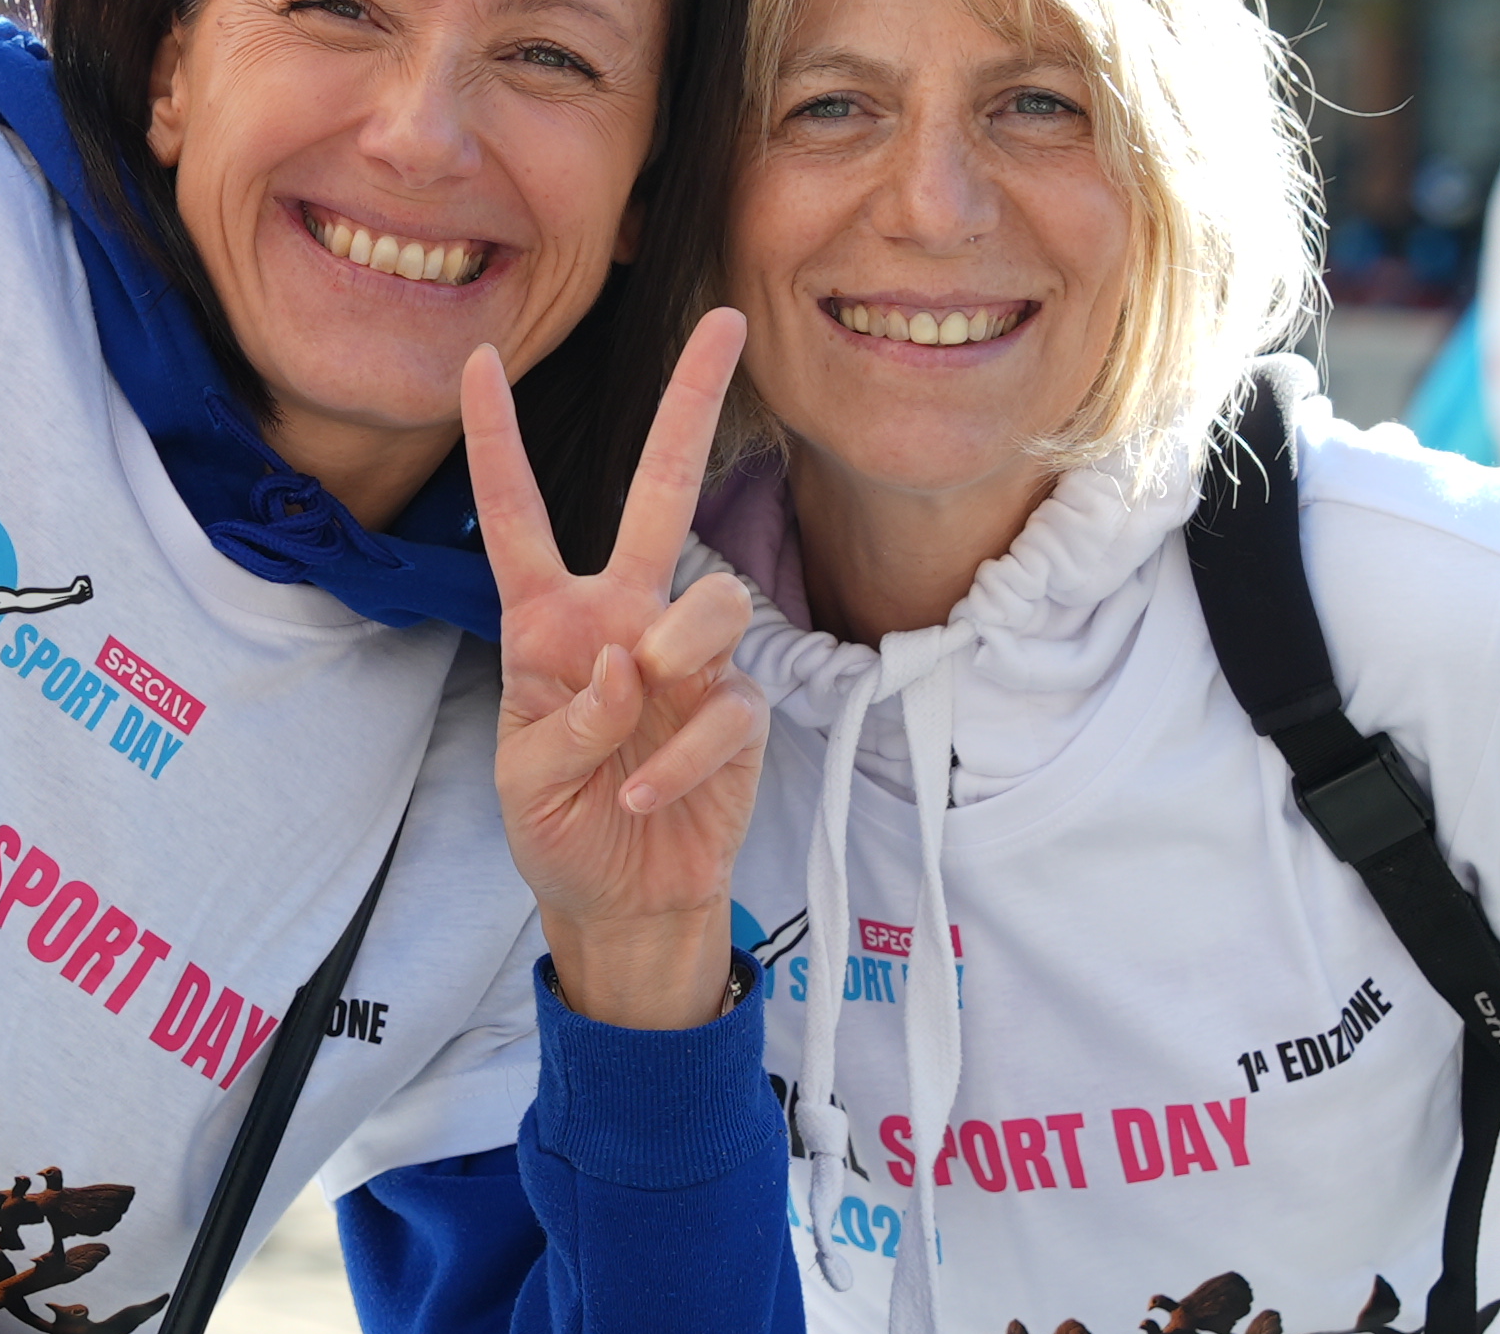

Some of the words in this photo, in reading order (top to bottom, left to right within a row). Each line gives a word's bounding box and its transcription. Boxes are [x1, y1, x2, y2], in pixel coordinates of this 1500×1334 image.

[0, 622, 118, 735] SPORT
[111, 704, 186, 783] DAY
[104, 644, 193, 729] SPECIAL
[147, 959, 280, 1092] DAY
[1111, 1096, 1254, 1187] DAY
